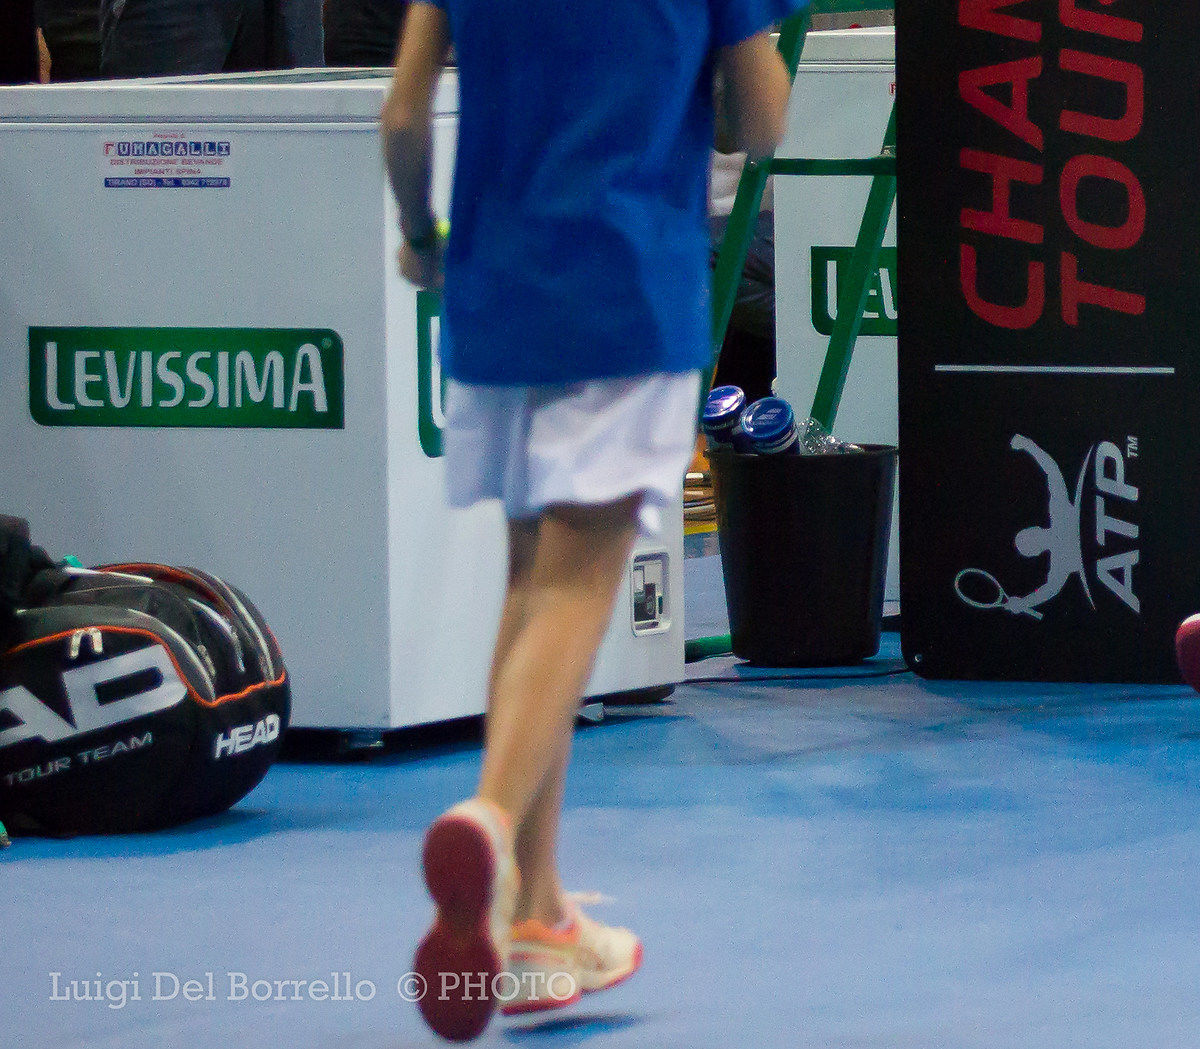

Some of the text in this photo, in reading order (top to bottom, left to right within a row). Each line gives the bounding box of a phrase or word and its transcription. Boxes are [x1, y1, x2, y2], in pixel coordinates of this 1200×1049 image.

[46, 341, 328, 412] LEVISSIMA
[1095, 440, 1141, 614] ATP
[5, 732, 154, 787] TOUR TEAM
[214, 713, 281, 760] HEAD
